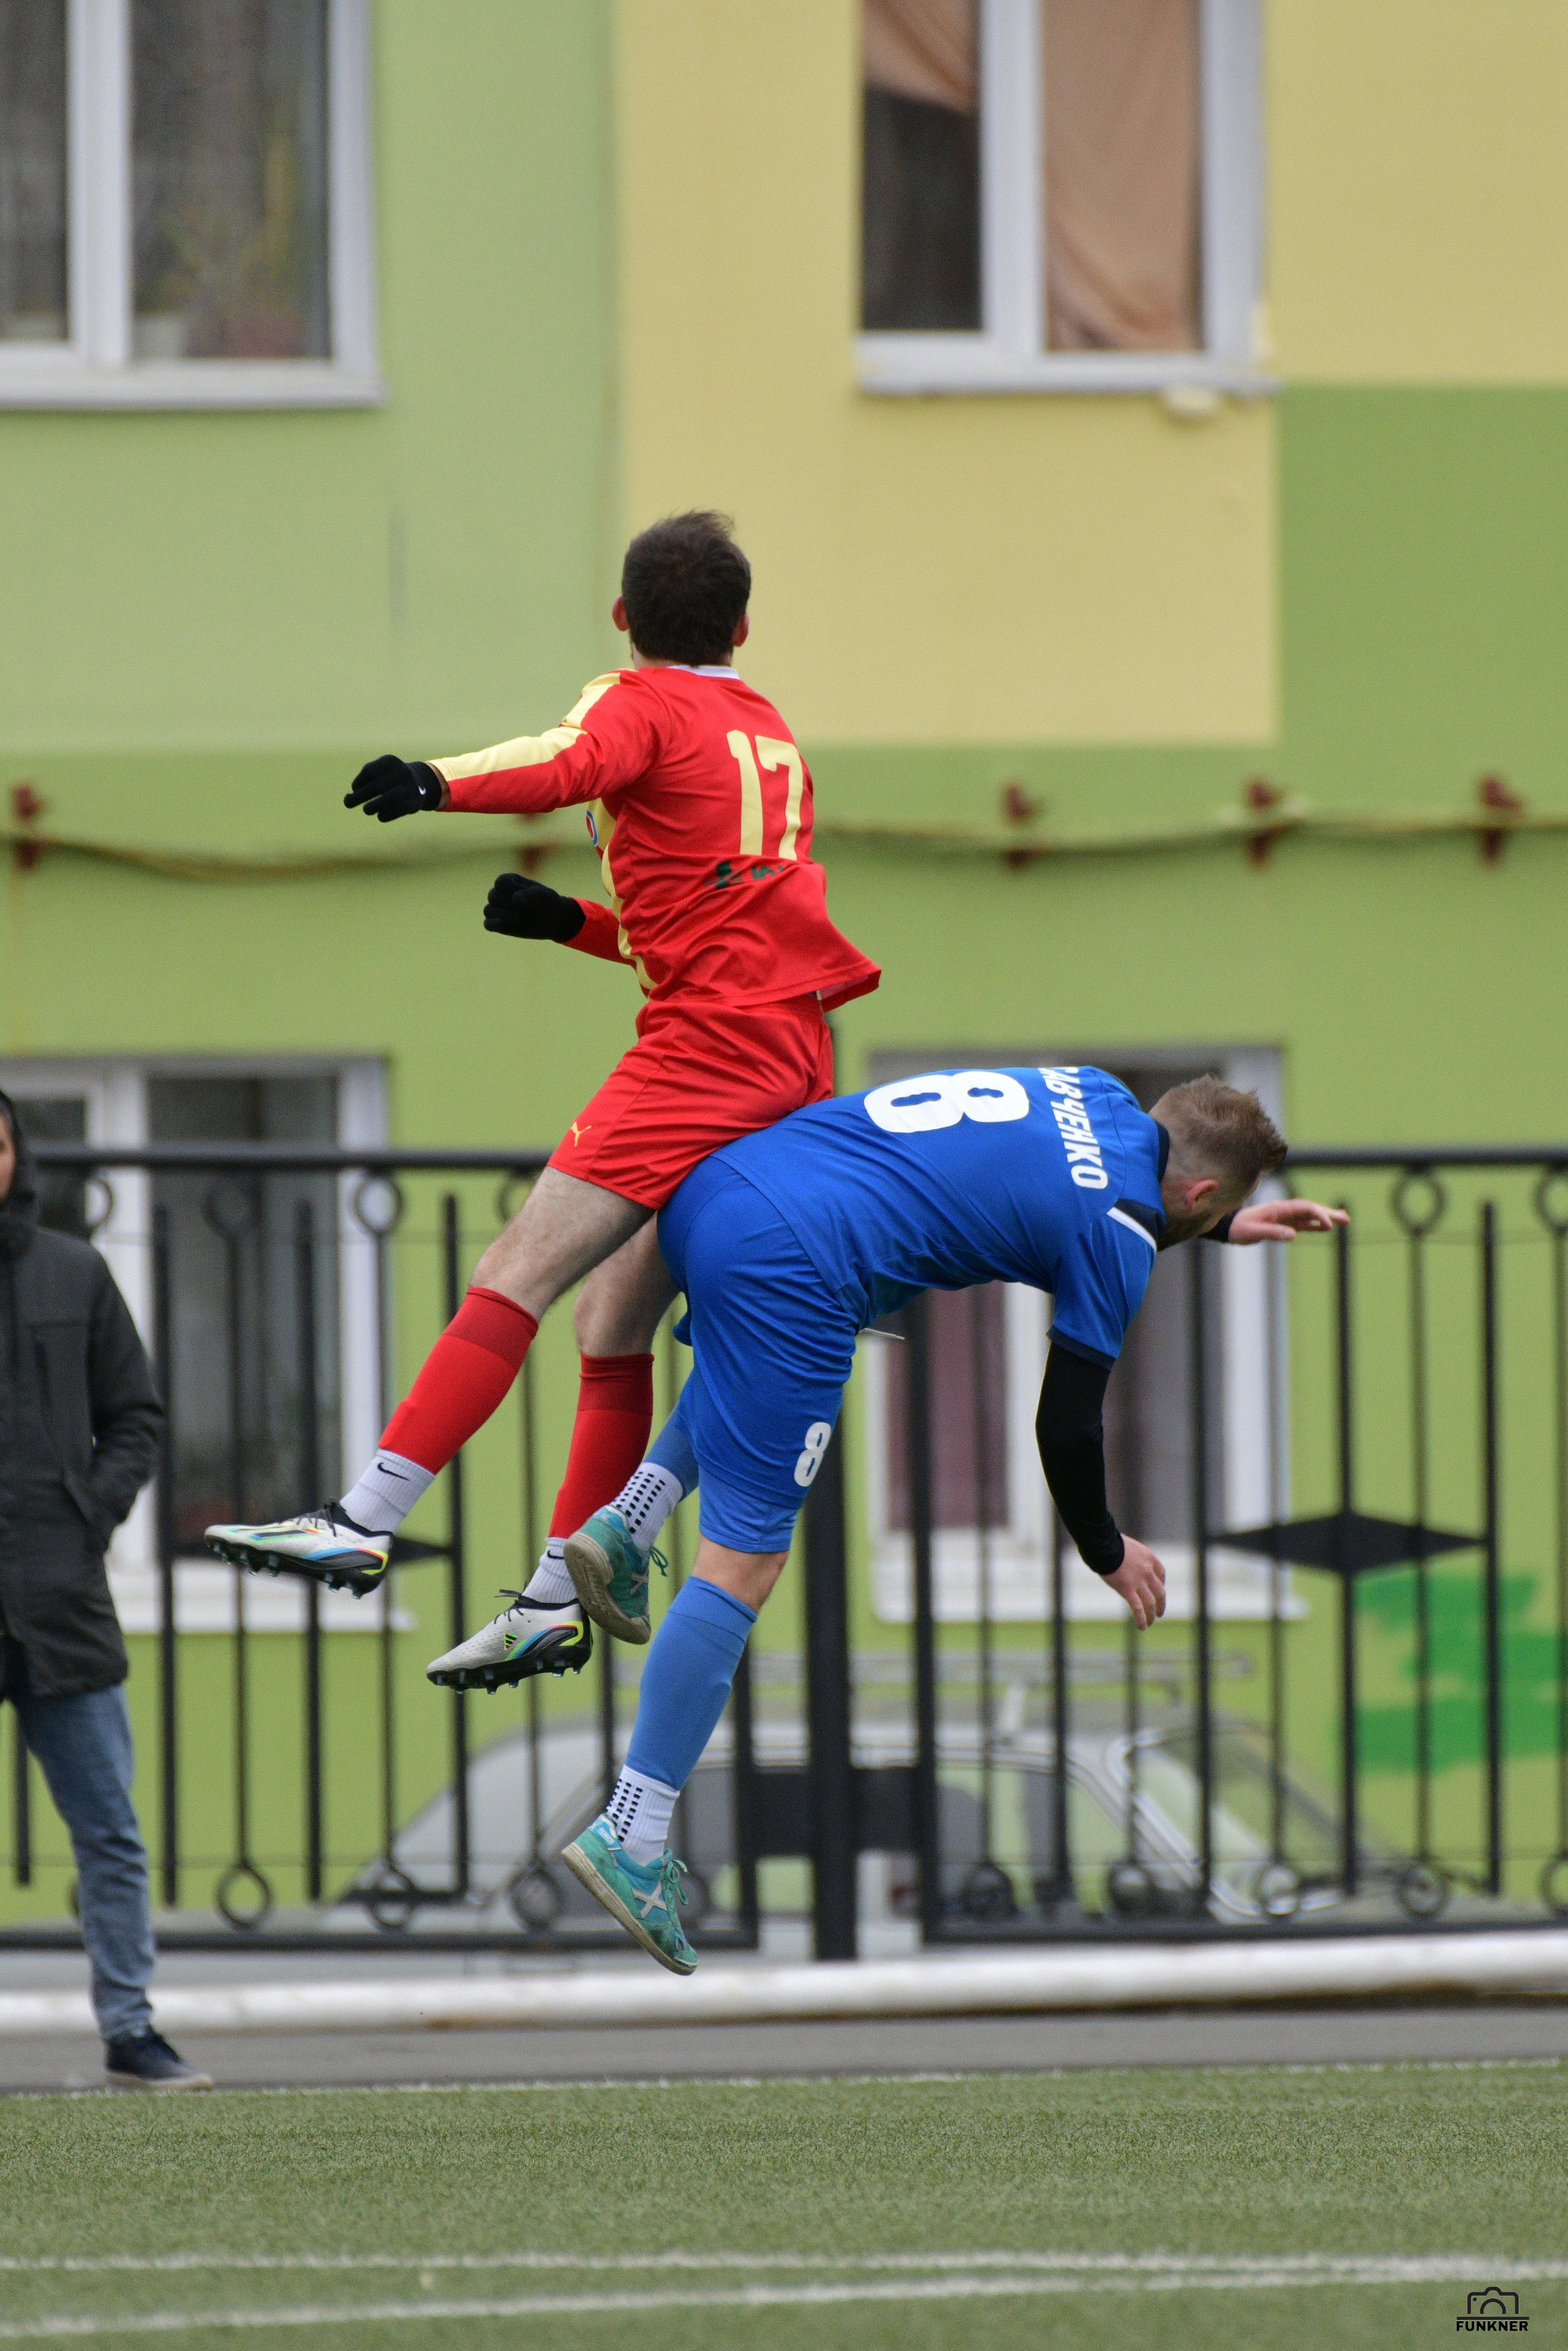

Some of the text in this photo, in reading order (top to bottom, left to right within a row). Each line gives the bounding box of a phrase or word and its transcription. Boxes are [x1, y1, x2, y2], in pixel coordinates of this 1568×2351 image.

[726, 730, 803, 861] 17
[863, 1071, 1030, 1133] 8
[794, 1422, 831, 1487] 8
